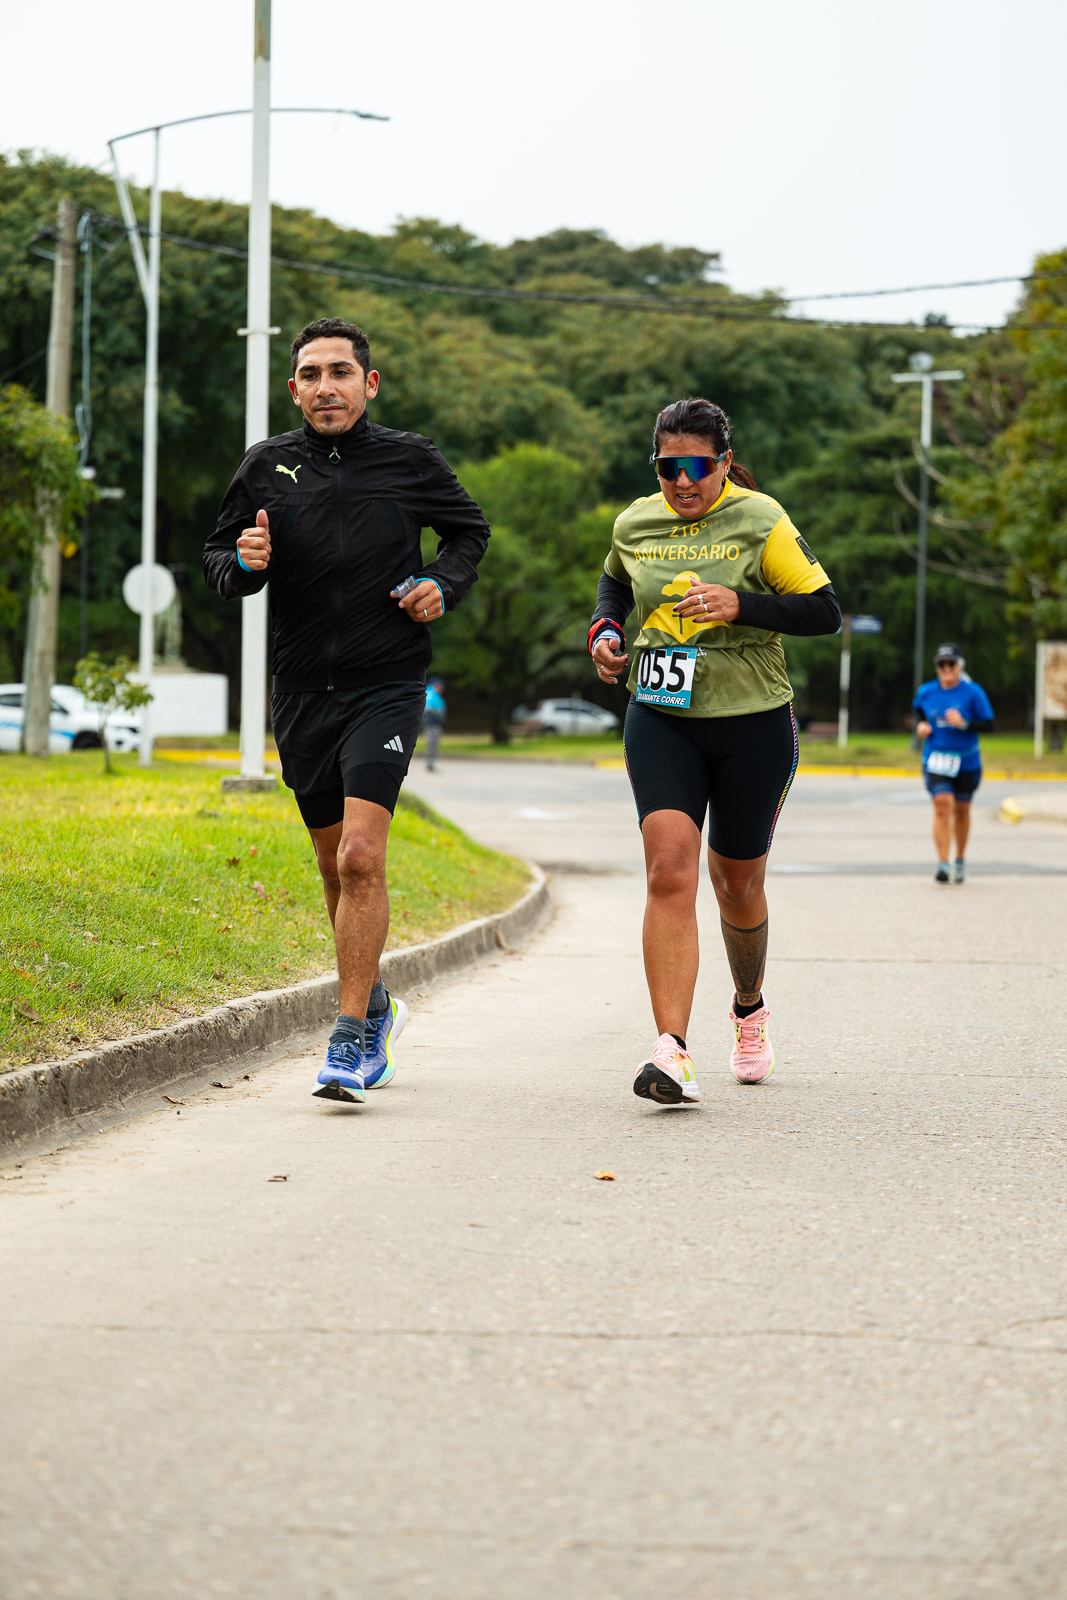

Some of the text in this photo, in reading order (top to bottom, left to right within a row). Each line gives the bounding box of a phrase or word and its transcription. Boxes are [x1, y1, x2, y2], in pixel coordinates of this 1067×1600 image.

[633, 544, 740, 562] ANIVERSARIO
[640, 648, 688, 694] 055
[637, 692, 687, 706] DIAMANTE CORRE
